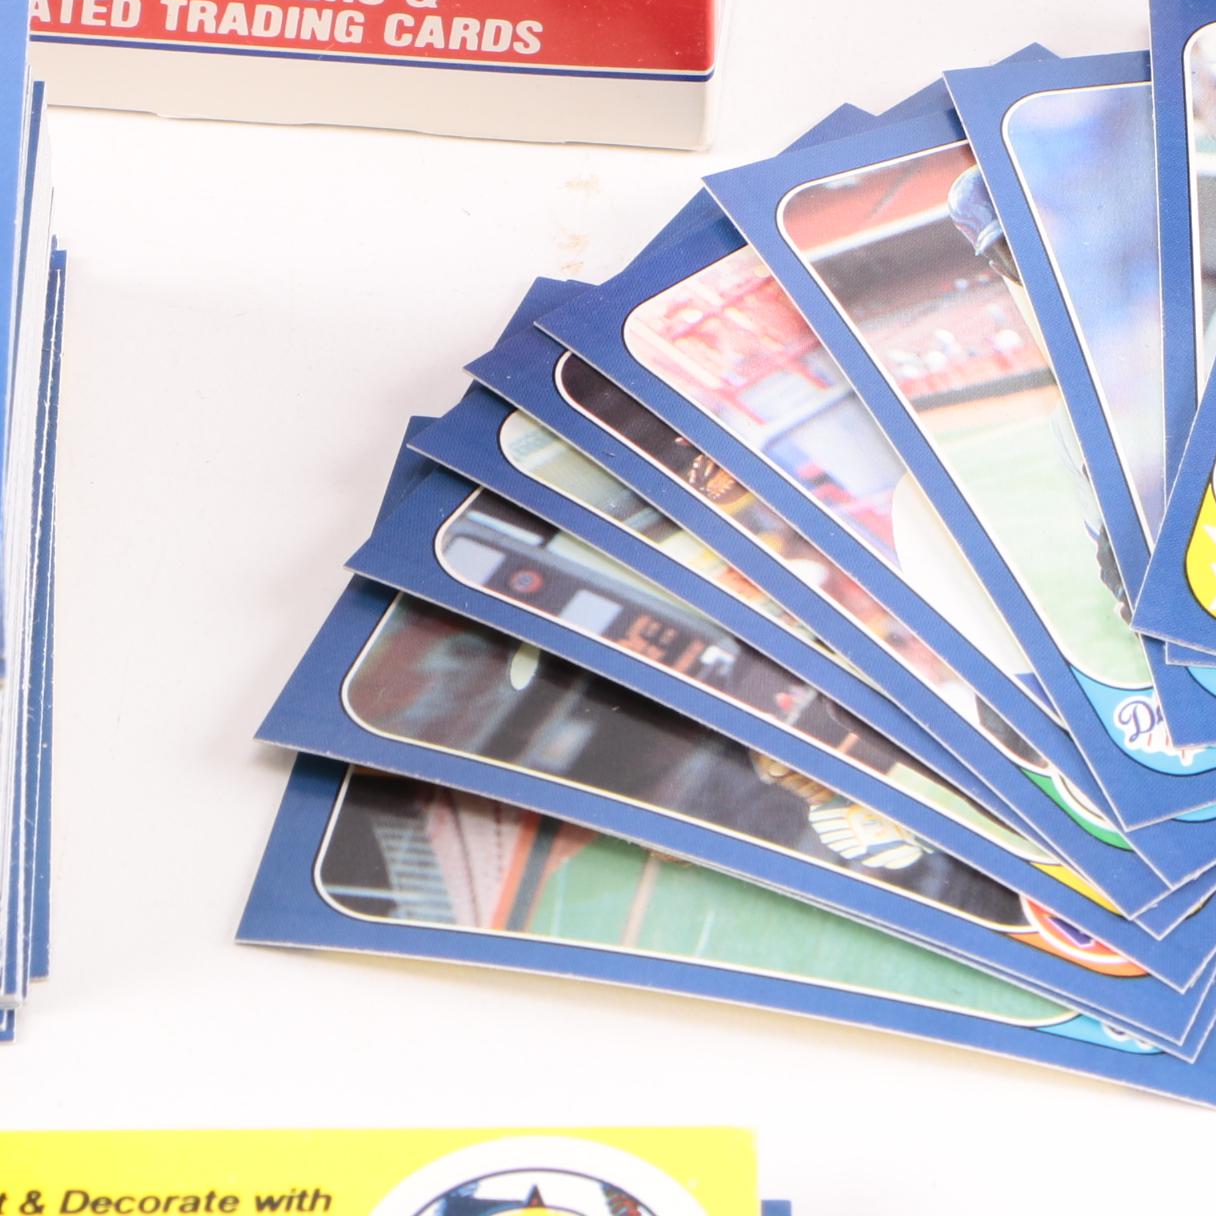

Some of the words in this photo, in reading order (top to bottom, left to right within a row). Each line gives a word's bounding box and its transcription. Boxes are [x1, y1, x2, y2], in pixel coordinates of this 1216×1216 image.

[383, 13, 543, 56] CARDS
[19, 1190, 45, 1215] &
[59, 1190, 240, 1215] Decorate
[255, 1188, 332, 1212] with
